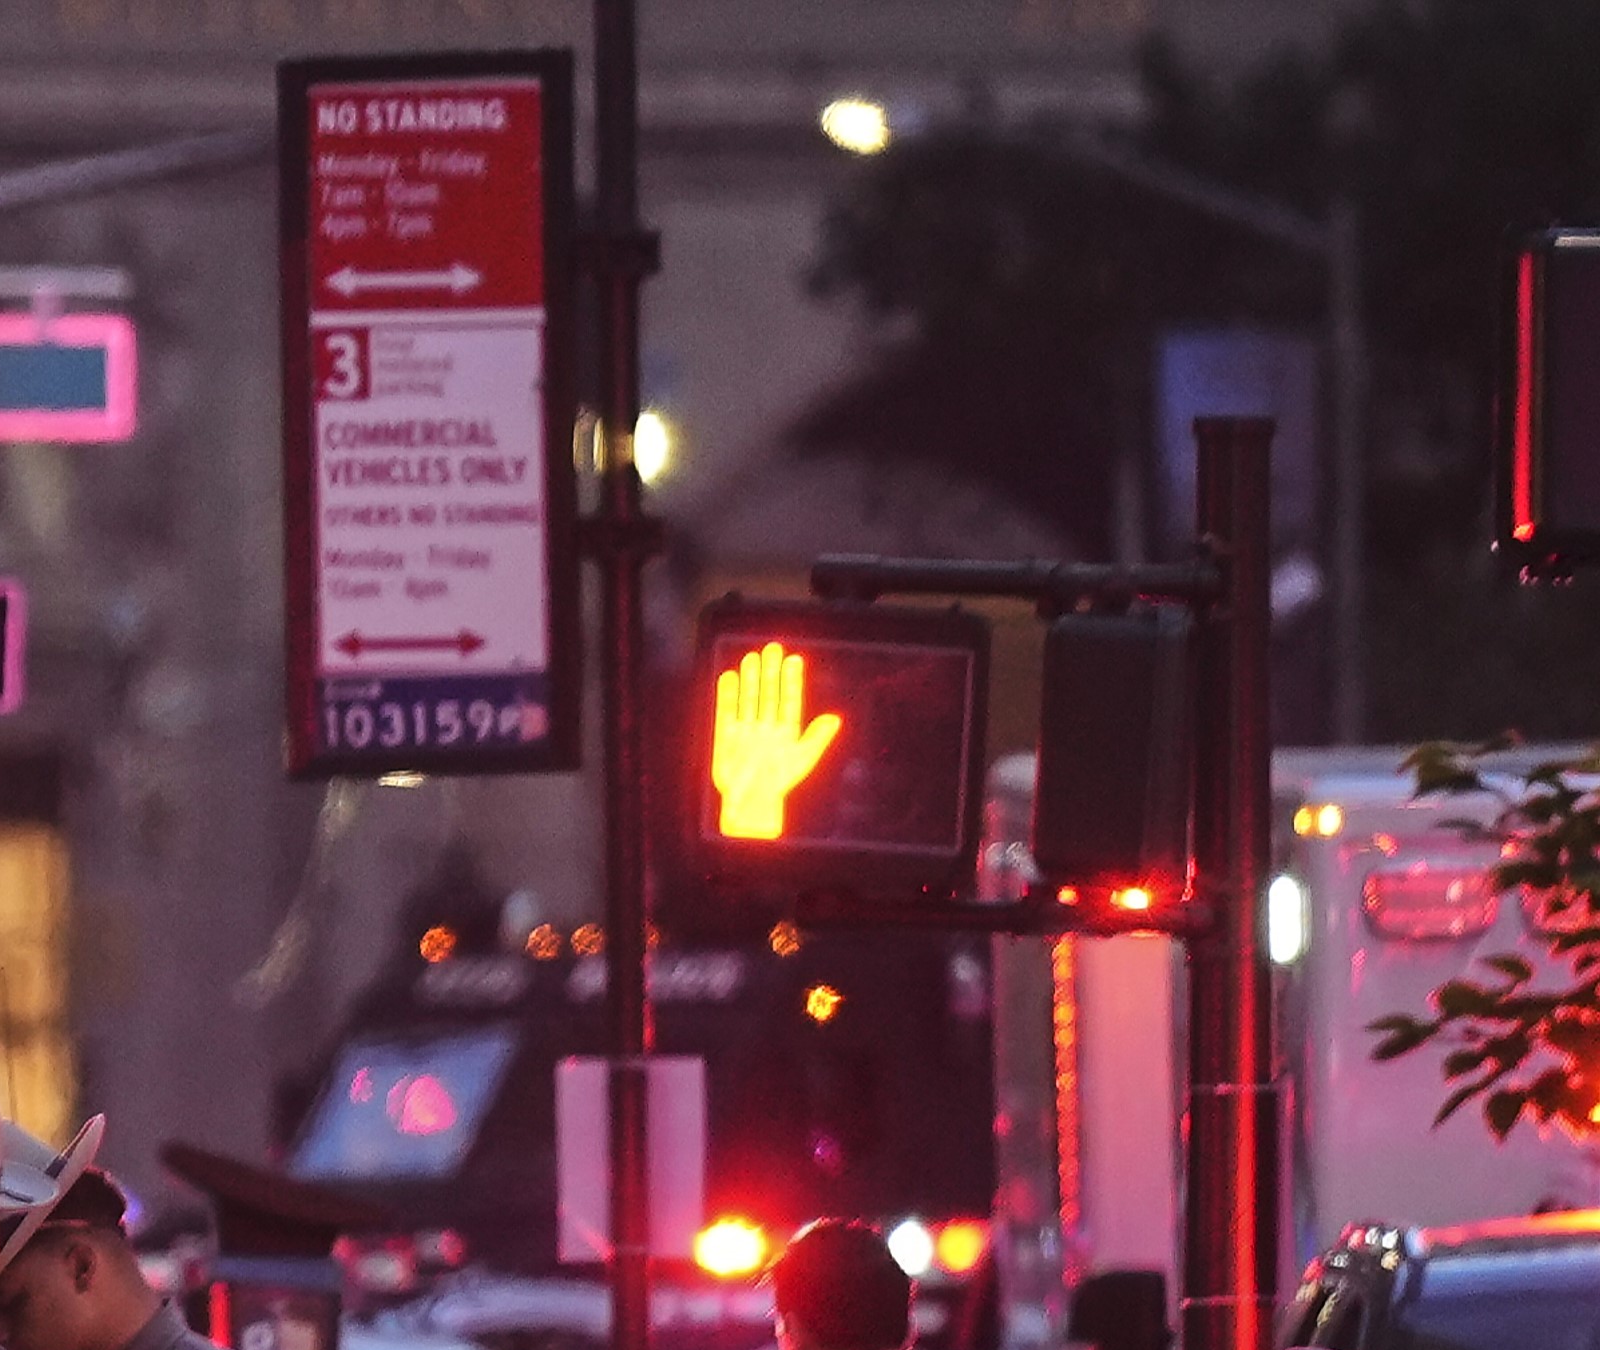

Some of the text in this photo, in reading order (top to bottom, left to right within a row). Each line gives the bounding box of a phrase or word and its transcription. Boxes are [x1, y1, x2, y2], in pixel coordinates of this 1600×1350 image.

[316, 98, 509, 133] NO STANDING
[324, 333, 361, 398] 3
[325, 419, 497, 449] COMMERCIAL
[326, 456, 528, 488] VEHICLES ONLY
[325, 700, 495, 748] 103159
